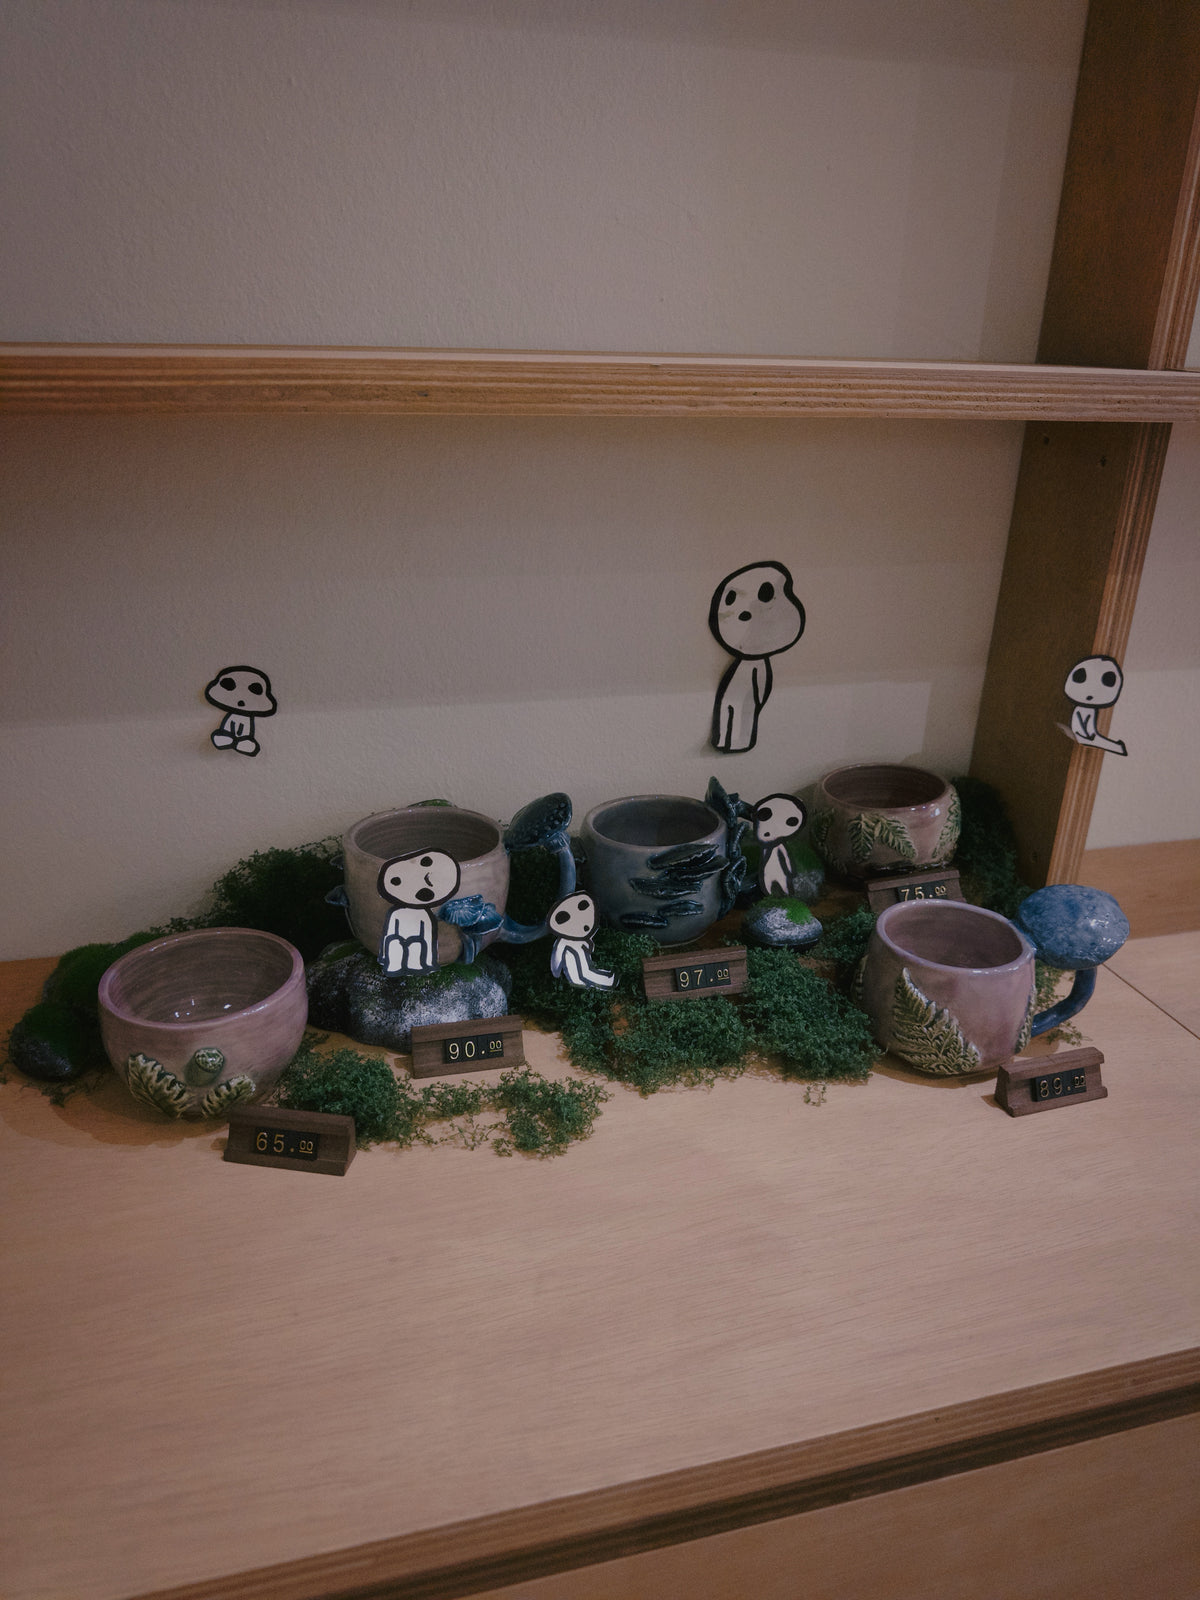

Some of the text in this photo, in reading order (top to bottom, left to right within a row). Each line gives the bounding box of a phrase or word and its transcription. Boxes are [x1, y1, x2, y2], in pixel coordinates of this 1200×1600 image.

[679, 968, 730, 988] 97.00
[449, 1040, 502, 1060] 90.00
[1039, 1075, 1086, 1098] 89.00
[256, 1131, 314, 1154] 65.00
